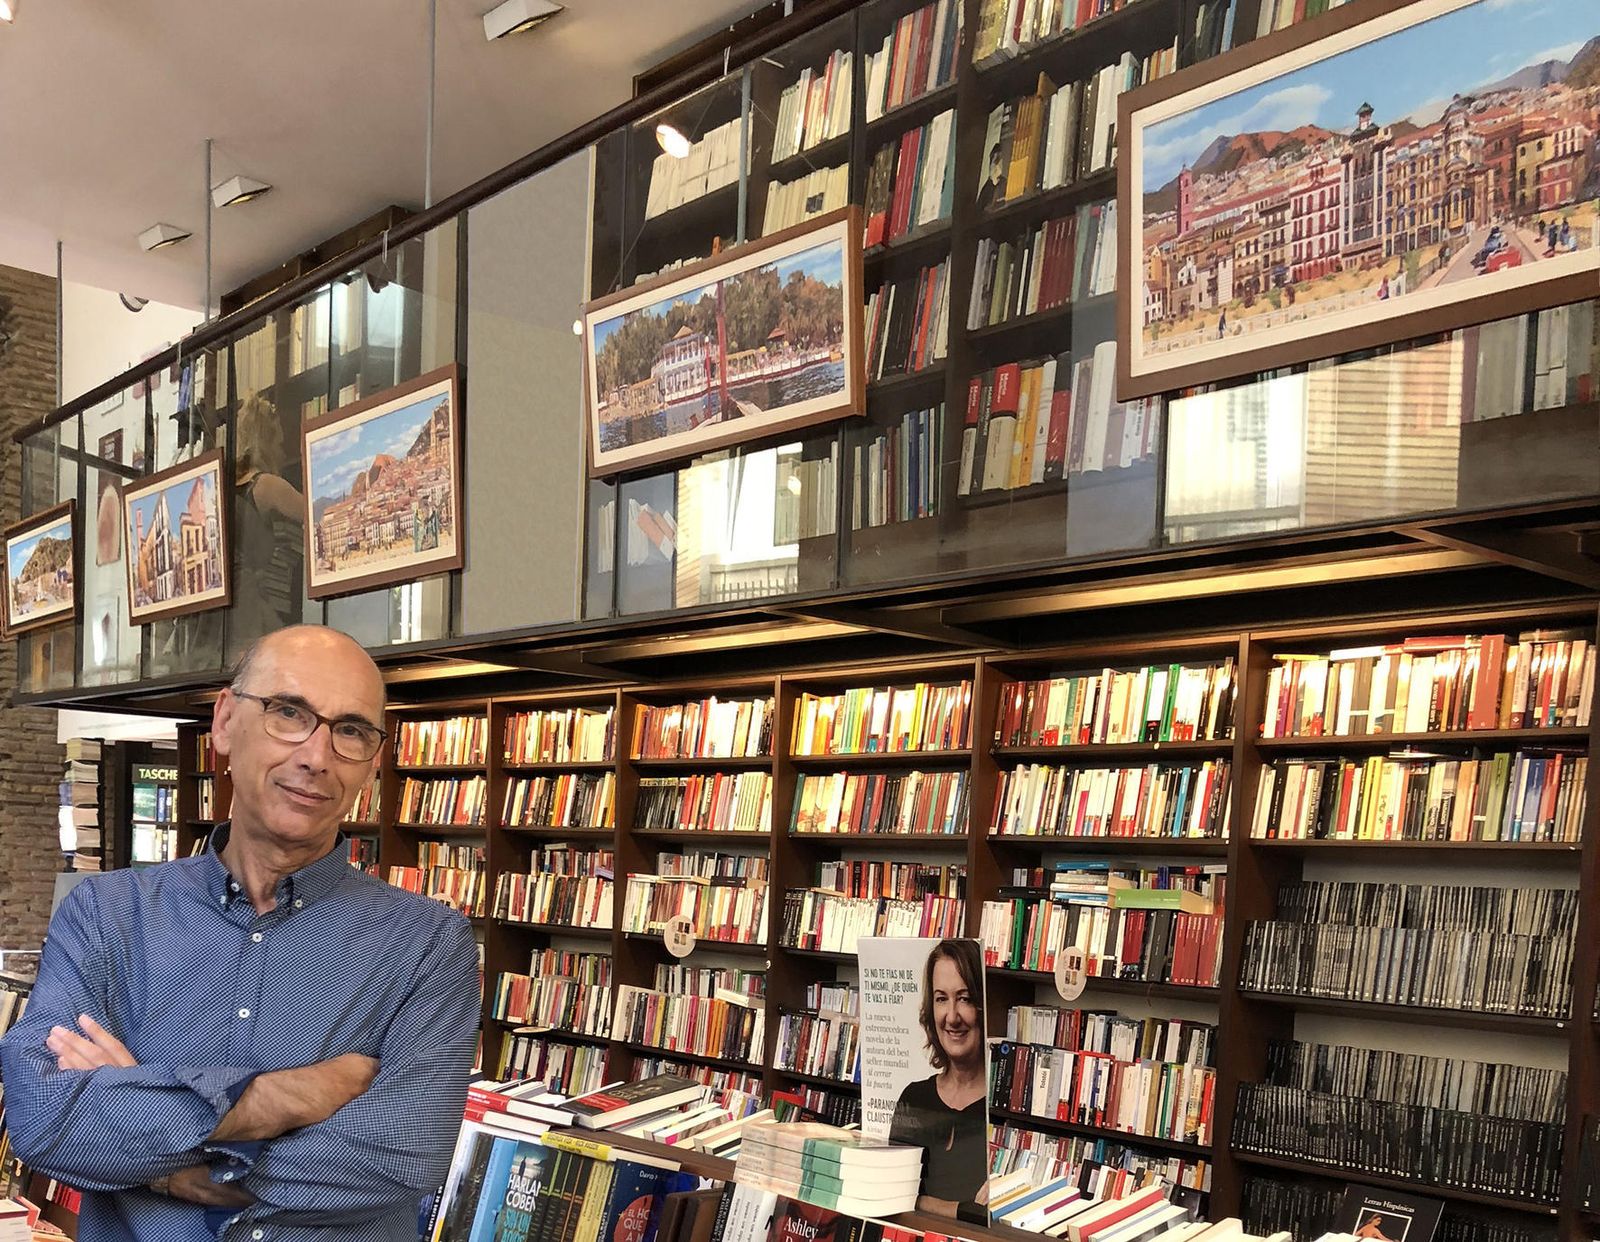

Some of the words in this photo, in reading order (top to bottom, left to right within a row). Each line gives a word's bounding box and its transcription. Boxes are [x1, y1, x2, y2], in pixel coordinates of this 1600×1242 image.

[138, 768, 178, 780] TASCHE
[864, 968, 869, 978] SI
[870, 968, 878, 978] NO
[879, 969, 885, 979] TE
[899, 969, 905, 980] NI
[906, 970, 913, 980] DE
[864, 980, 870, 990] TI
[902, 980, 918, 993] QUIÉN
[865, 993, 870, 1003] TE
[872, 994, 882, 1003] VAS
[884, 994, 887, 1003] A
[889, 994, 903, 1005] FIAR?
[624, 1218, 644, 1232] QUE
[784, 1217, 818, 1239] Ashley
